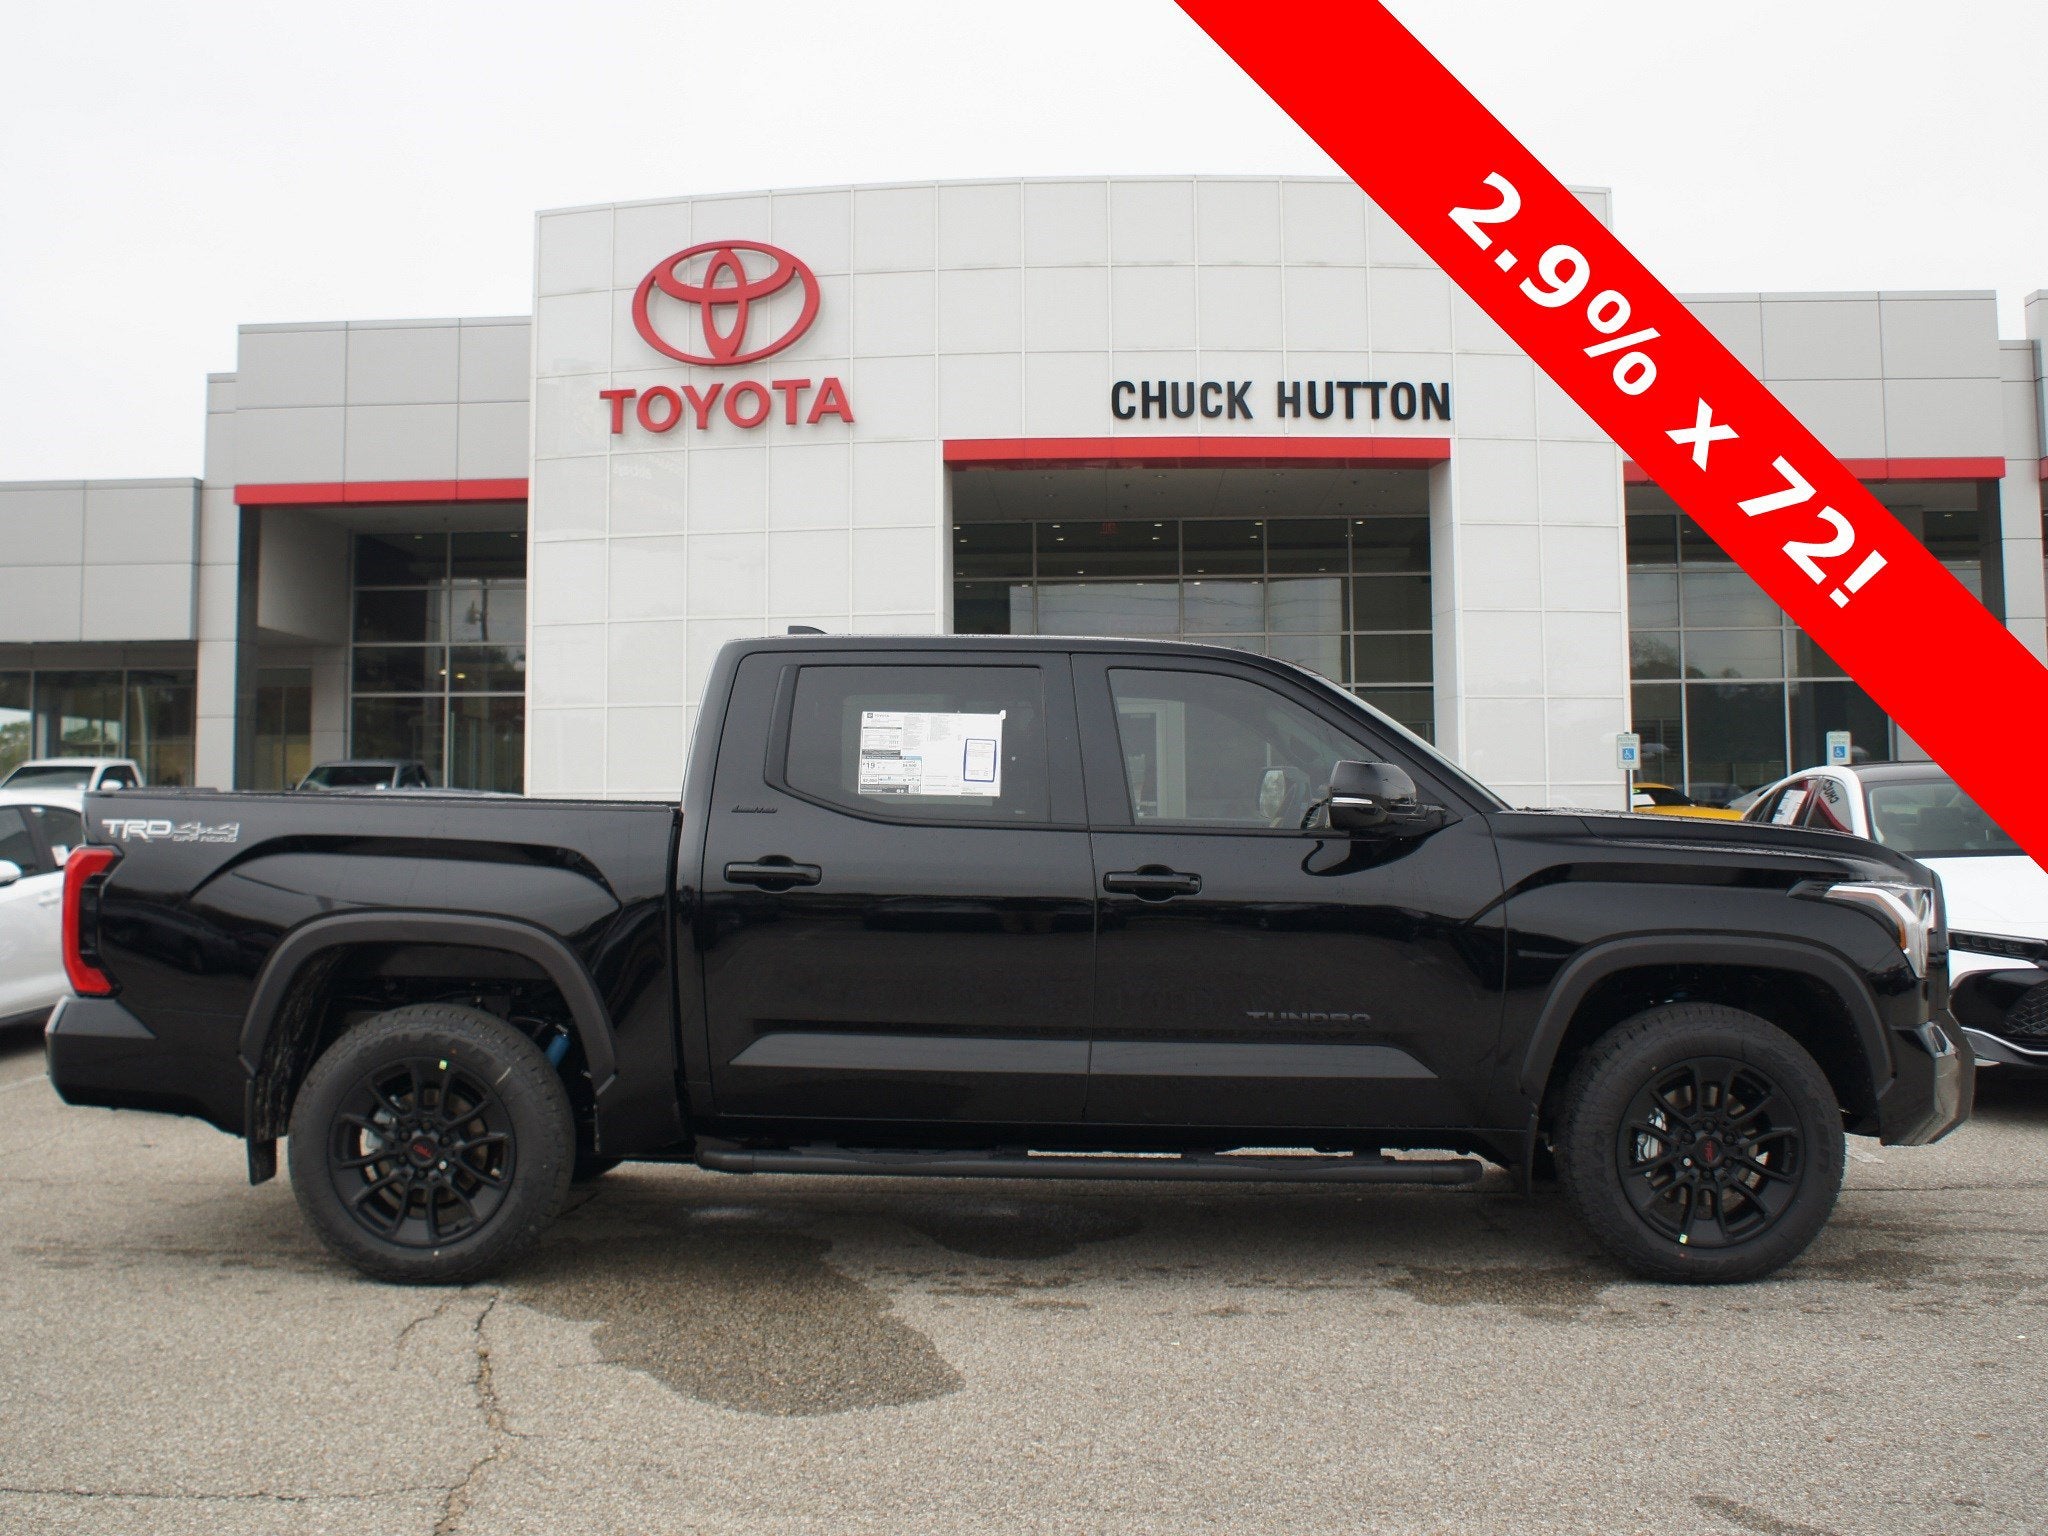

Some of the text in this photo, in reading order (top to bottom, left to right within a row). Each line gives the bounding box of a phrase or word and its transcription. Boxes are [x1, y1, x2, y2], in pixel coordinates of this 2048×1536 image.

[600, 377, 855, 434] TOYOTA
[1111, 381, 1451, 421] CHUCK HUTTON
[102, 819, 172, 840] TRD
